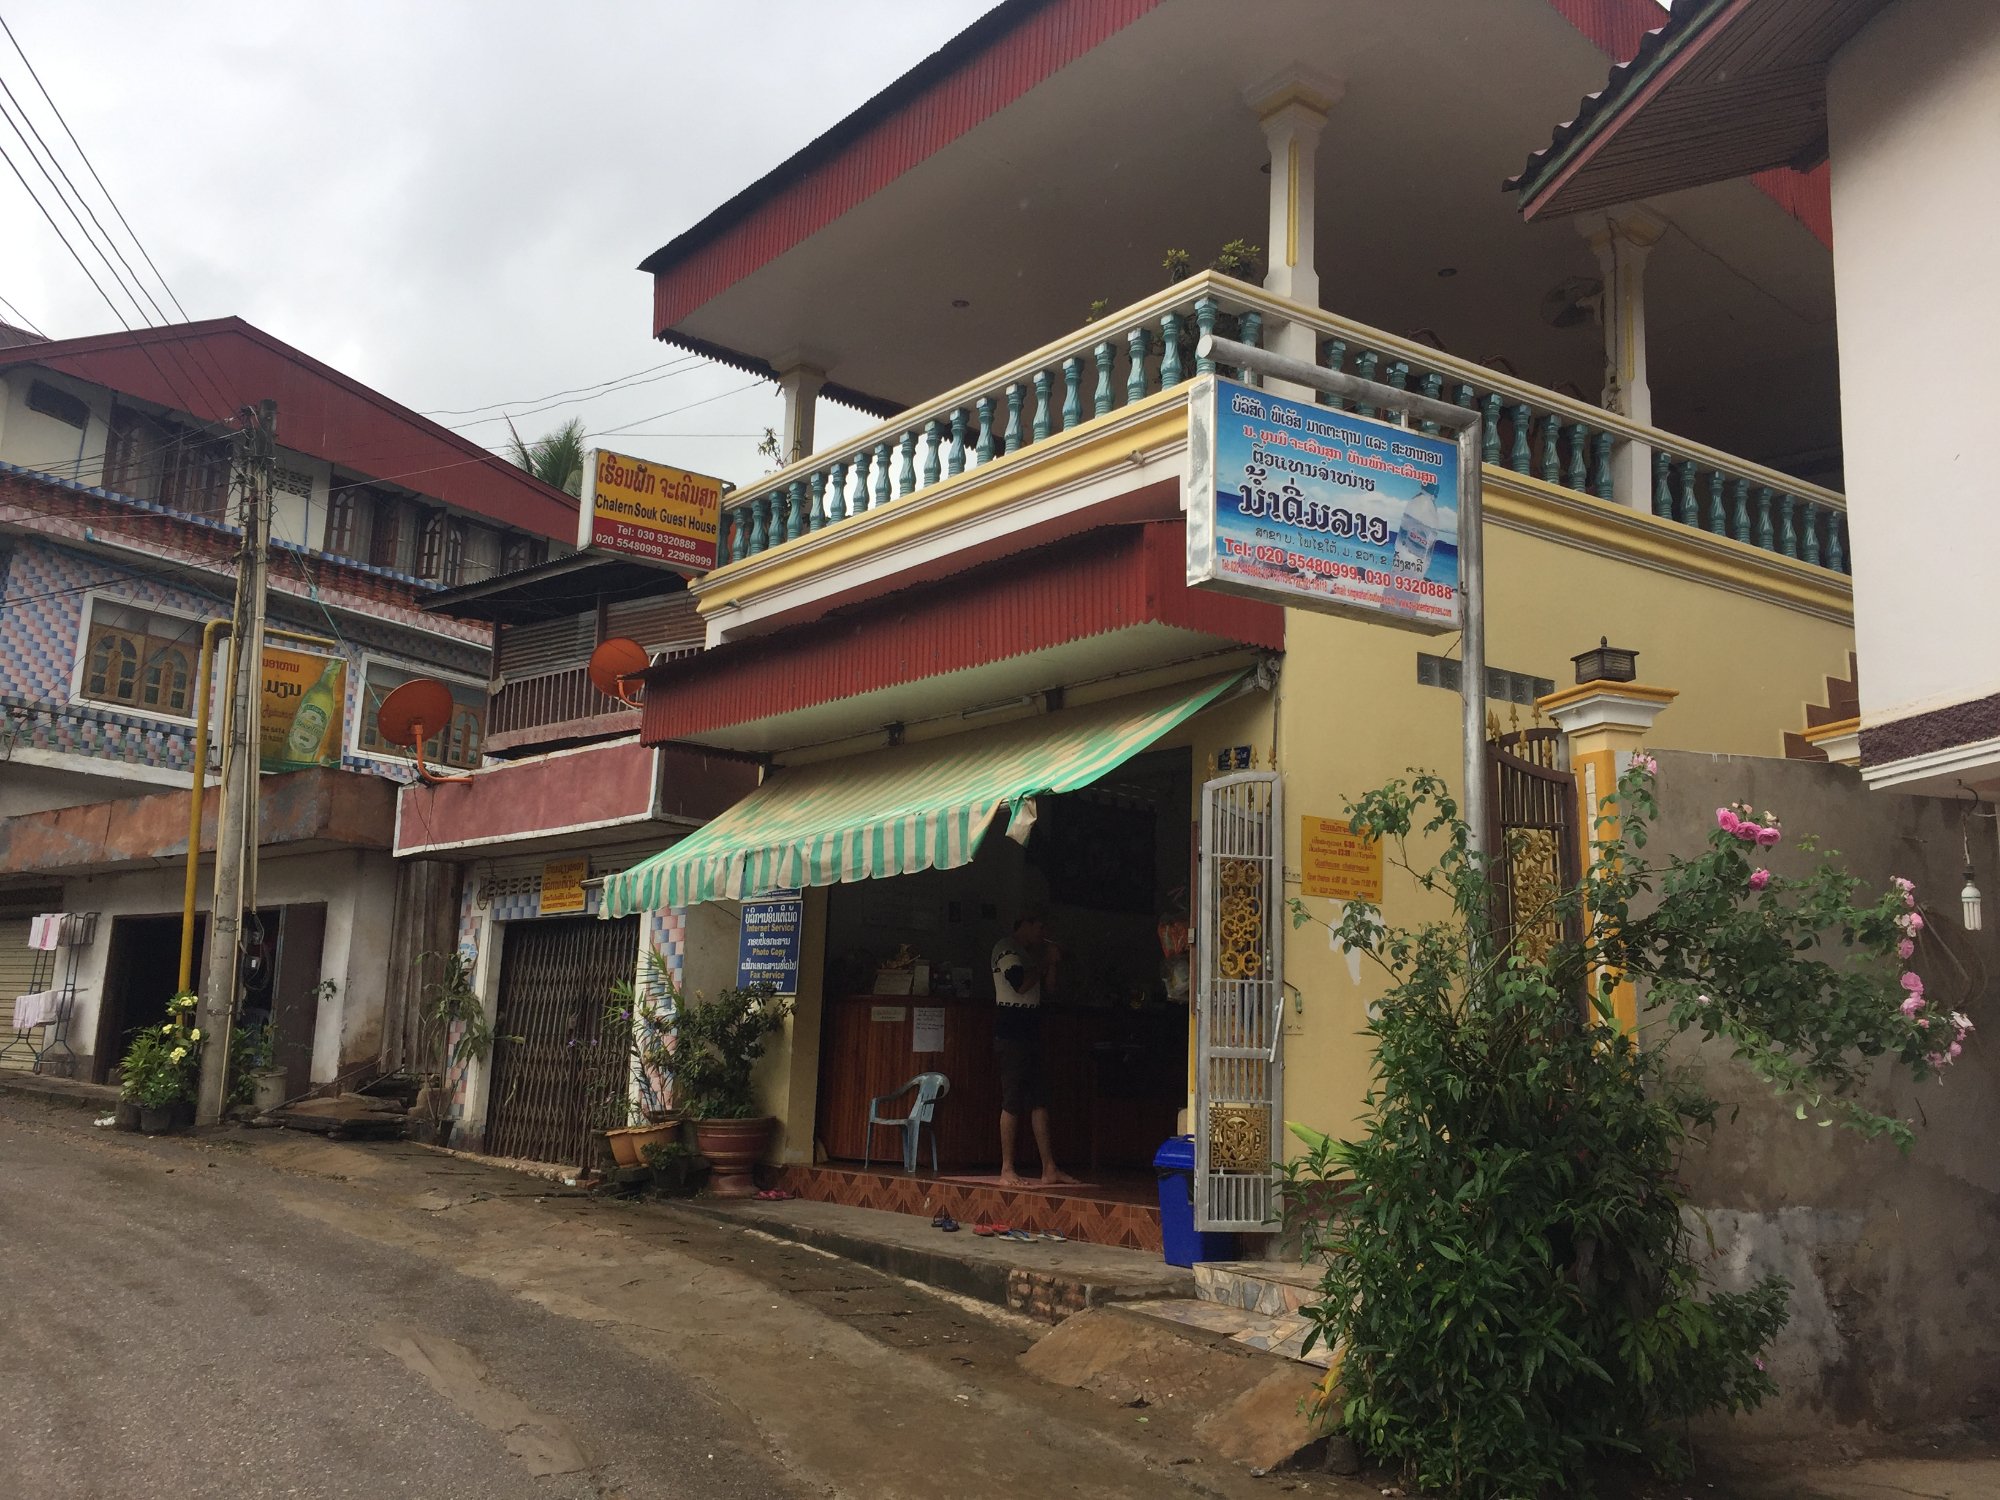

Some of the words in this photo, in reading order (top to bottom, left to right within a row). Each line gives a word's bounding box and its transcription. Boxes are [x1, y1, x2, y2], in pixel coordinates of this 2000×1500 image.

[1366, 436, 1387, 451] ແລະ
[659, 509, 687, 528] Guest
[688, 516, 717, 535] House
[617, 524, 635, 537] Tel:
[637, 528, 654, 541] 030
[657, 533, 697, 550] 9320888
[596, 533, 614, 545] 020
[667, 549, 712, 566] 22968999
[1224, 538, 1252, 558] Tel:
[1256, 545, 1285, 565] 020
[1288, 553, 1361, 584] 55480999,
[1364, 569, 1391, 588] 030
[1395, 575, 1453, 600] 9320888
[771, 923, 795, 932] Service
[752, 947, 769, 956] Photo
[770, 947, 787, 957] Copy
[750, 970, 761, 979] Fax
[762, 970, 785, 980] Service
